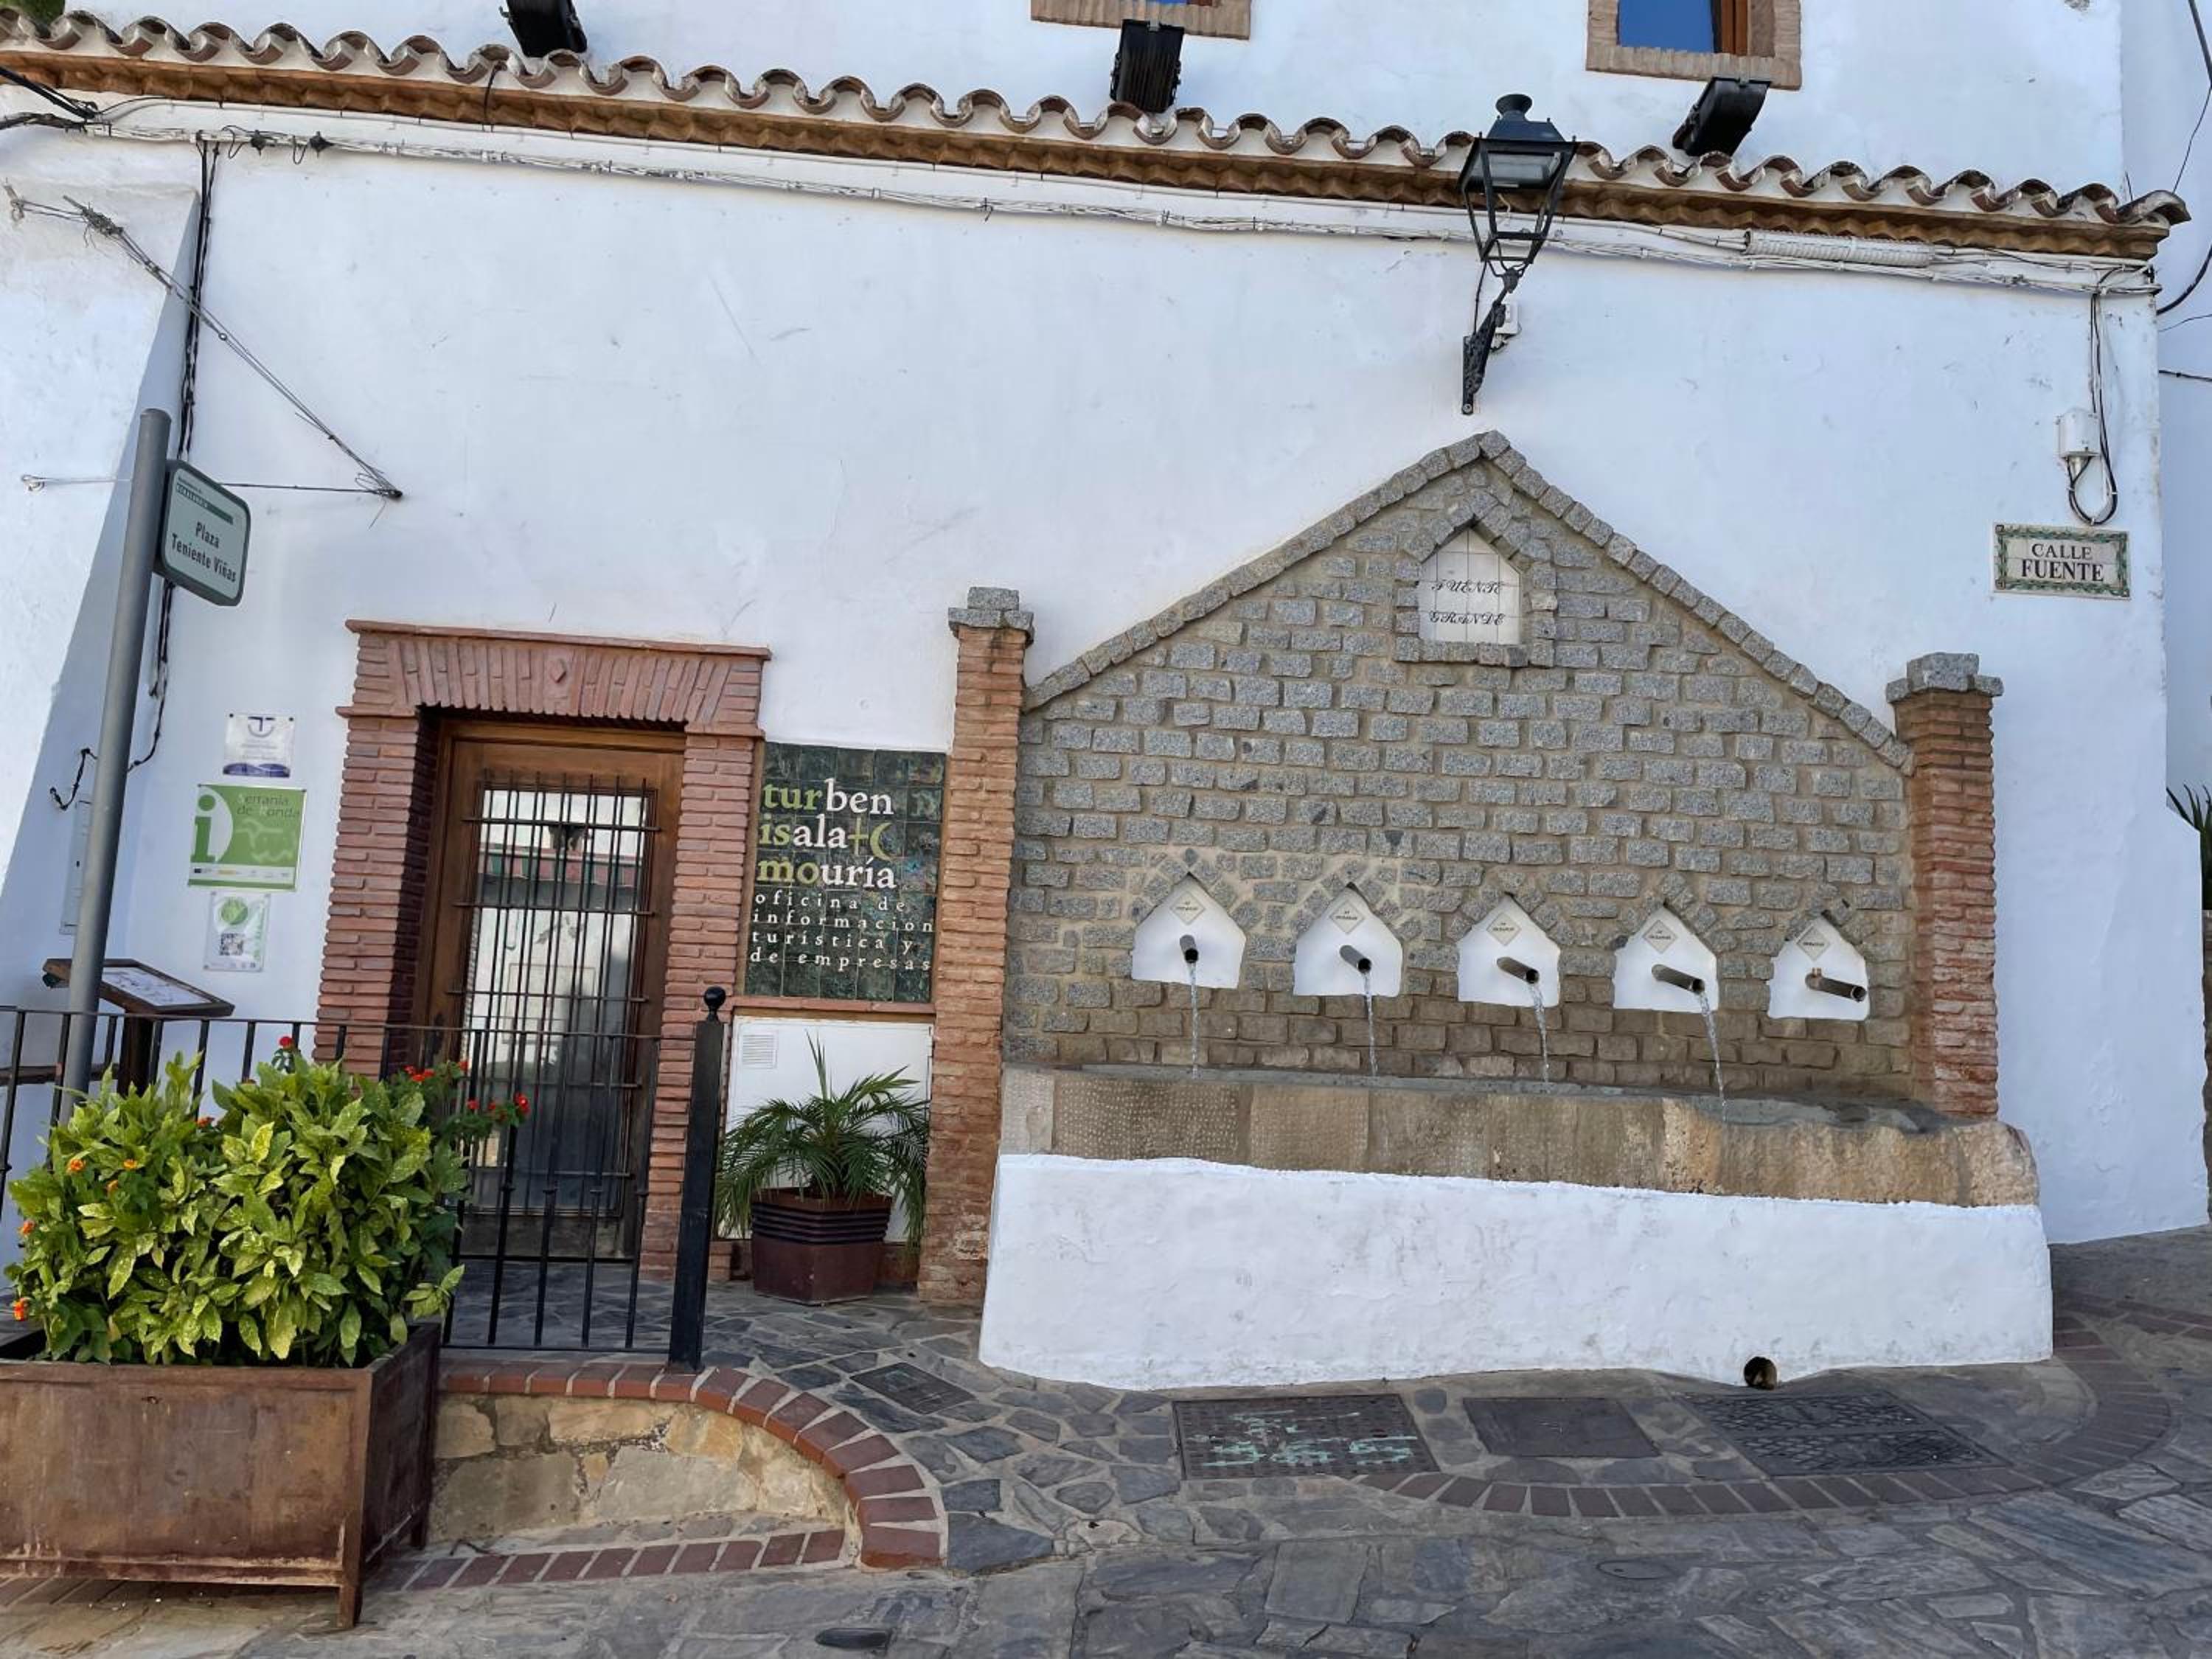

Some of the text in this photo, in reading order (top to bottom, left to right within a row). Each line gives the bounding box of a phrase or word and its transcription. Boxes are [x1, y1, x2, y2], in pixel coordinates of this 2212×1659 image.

[195, 521, 220, 549] Plaza
[172, 533, 237, 583] Teniente Viñas
[2031, 543, 2093, 560] CALLE
[2022, 559, 2104, 581] FUENTE
[1430, 610, 1506, 626] GRANDE
[236, 805, 253, 816] de
[755, 889, 905, 912] oficina de
[902, 940, 914, 955] y
[750, 947, 931, 972] de empresas
